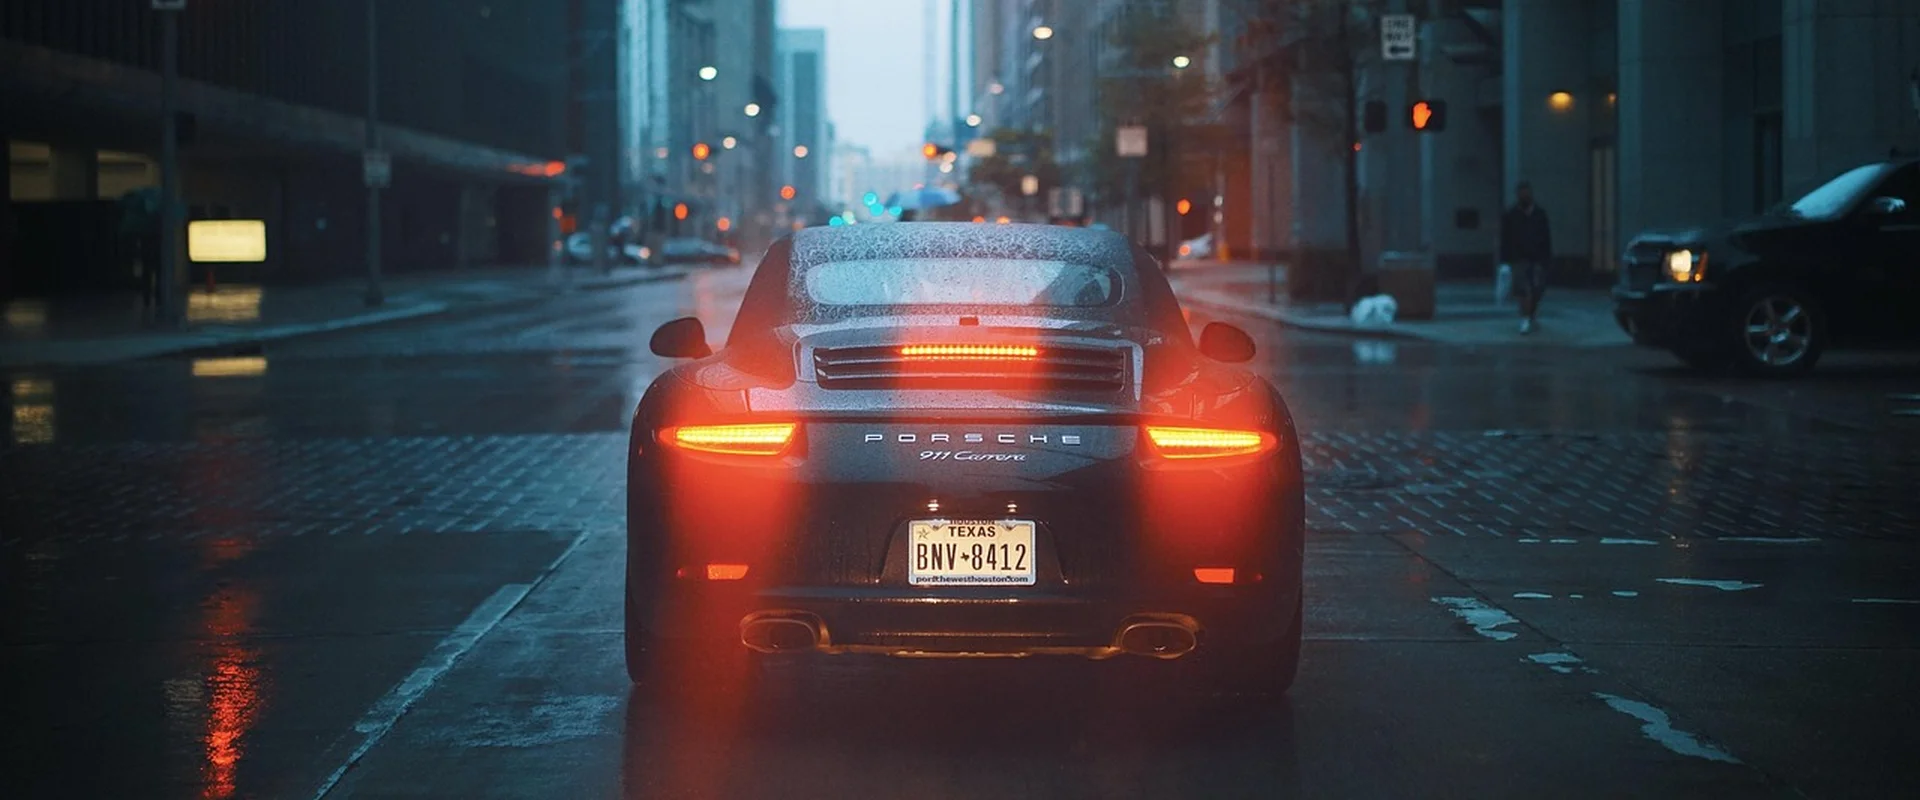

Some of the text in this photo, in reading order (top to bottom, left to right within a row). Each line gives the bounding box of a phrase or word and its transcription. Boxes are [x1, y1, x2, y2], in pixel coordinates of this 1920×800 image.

[865, 433, 1080, 445] PORSCHE
[919, 451, 1028, 461] 911 Carrera
[948, 526, 997, 537] TEXAS
[917, 543, 1026, 571] BNV 8412
